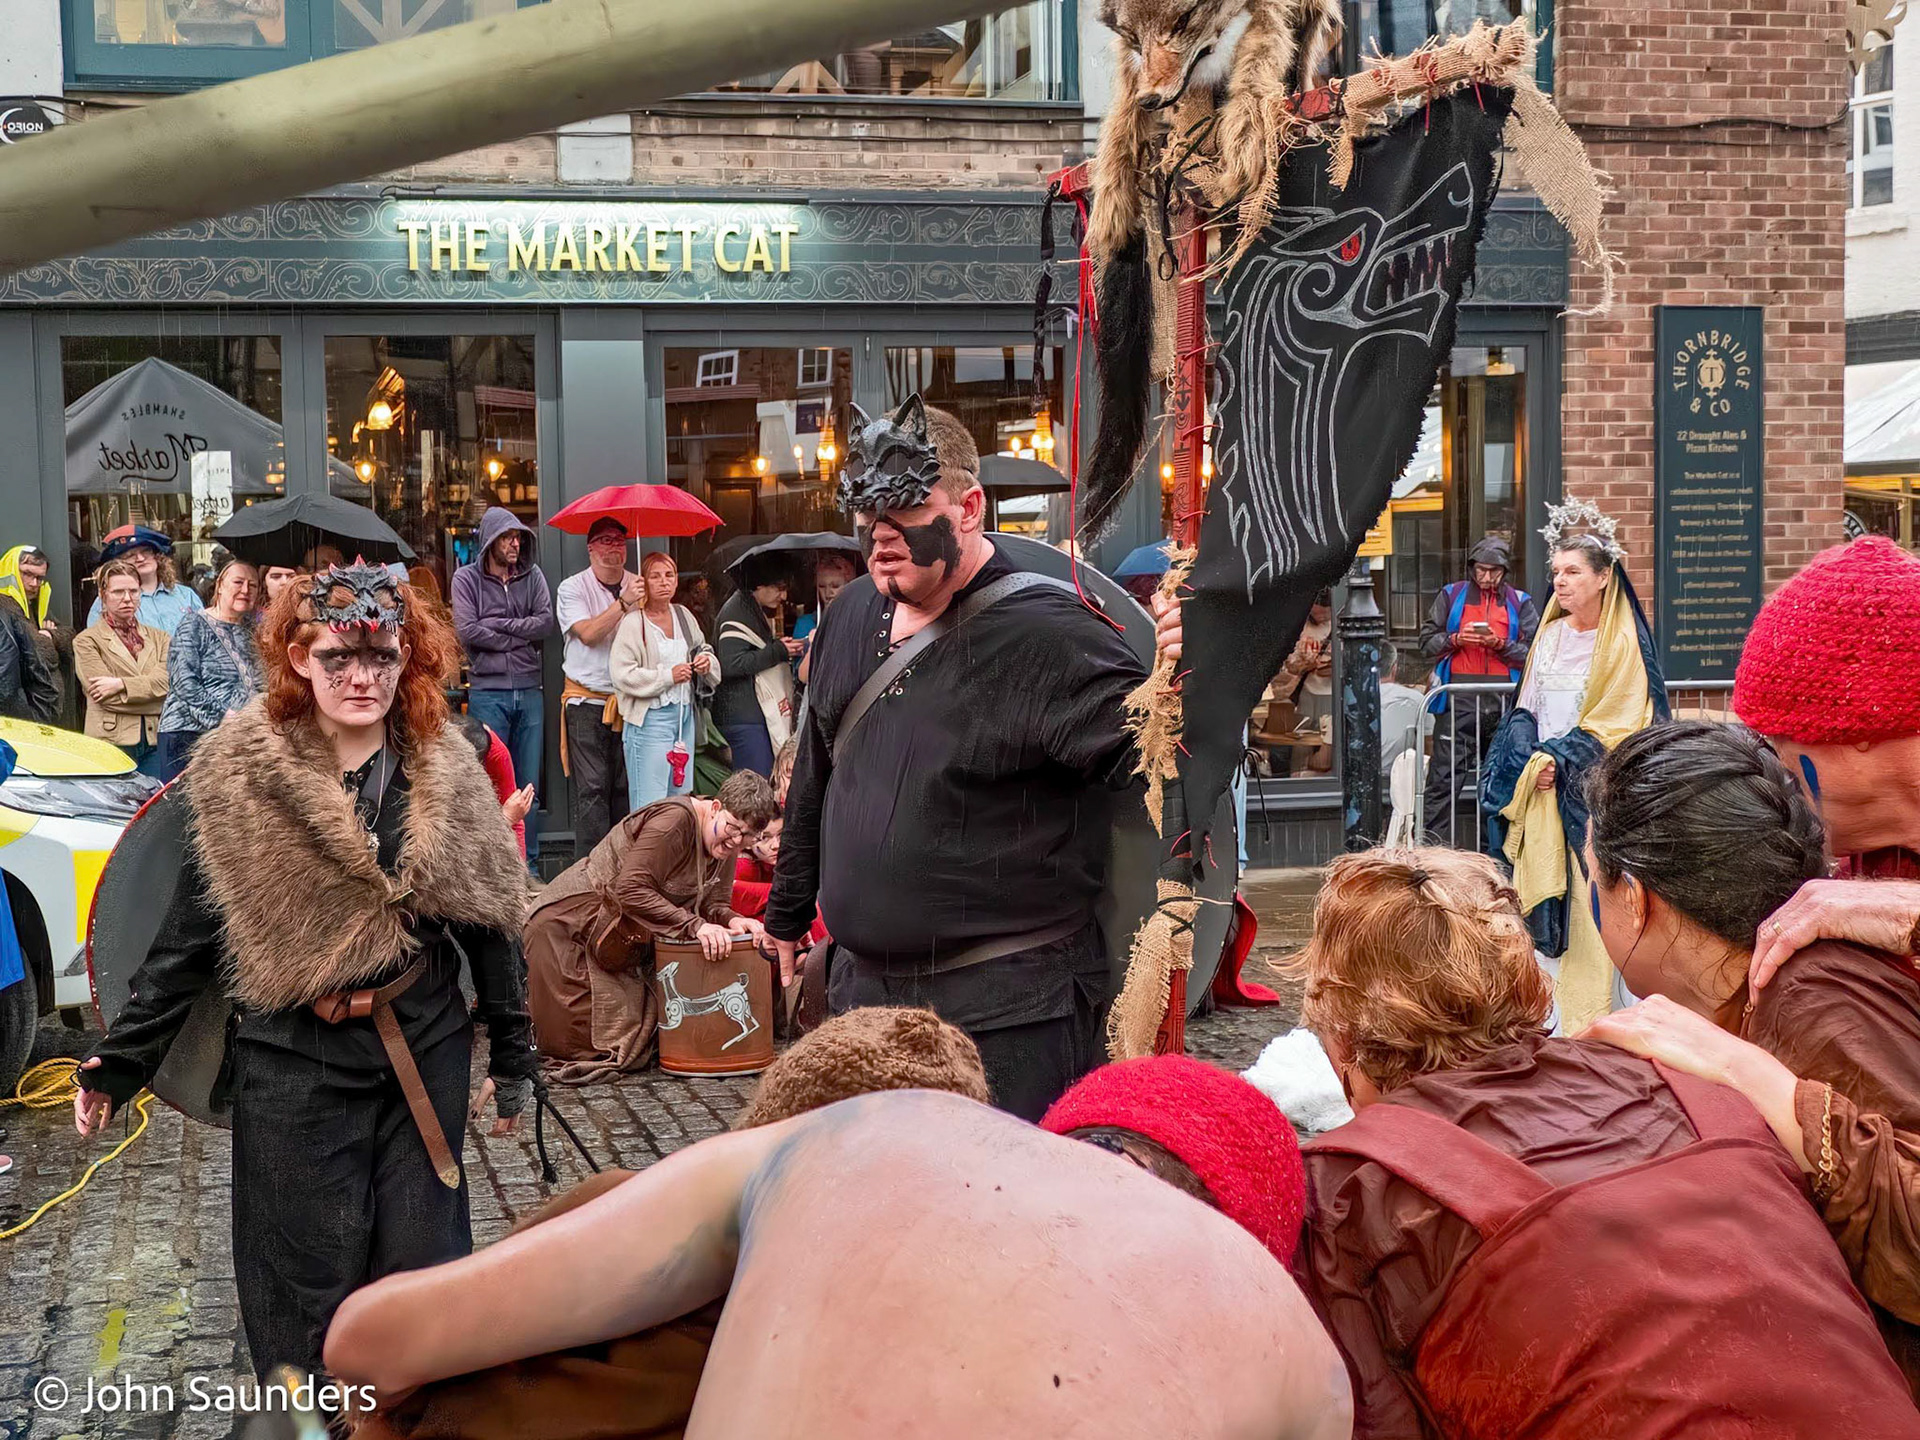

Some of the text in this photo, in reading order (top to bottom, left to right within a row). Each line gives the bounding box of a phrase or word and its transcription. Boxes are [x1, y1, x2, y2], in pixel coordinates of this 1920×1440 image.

[398, 220, 800, 273] THE MARKET CAT
[1673, 330, 1751, 391] THORNBRIDGE
[1690, 397, 1731, 417] & CO
[1676, 430, 1688, 441] 22
[1689, 430, 1721, 443] Draught
[1708, 443, 1738, 453] Kitchen
